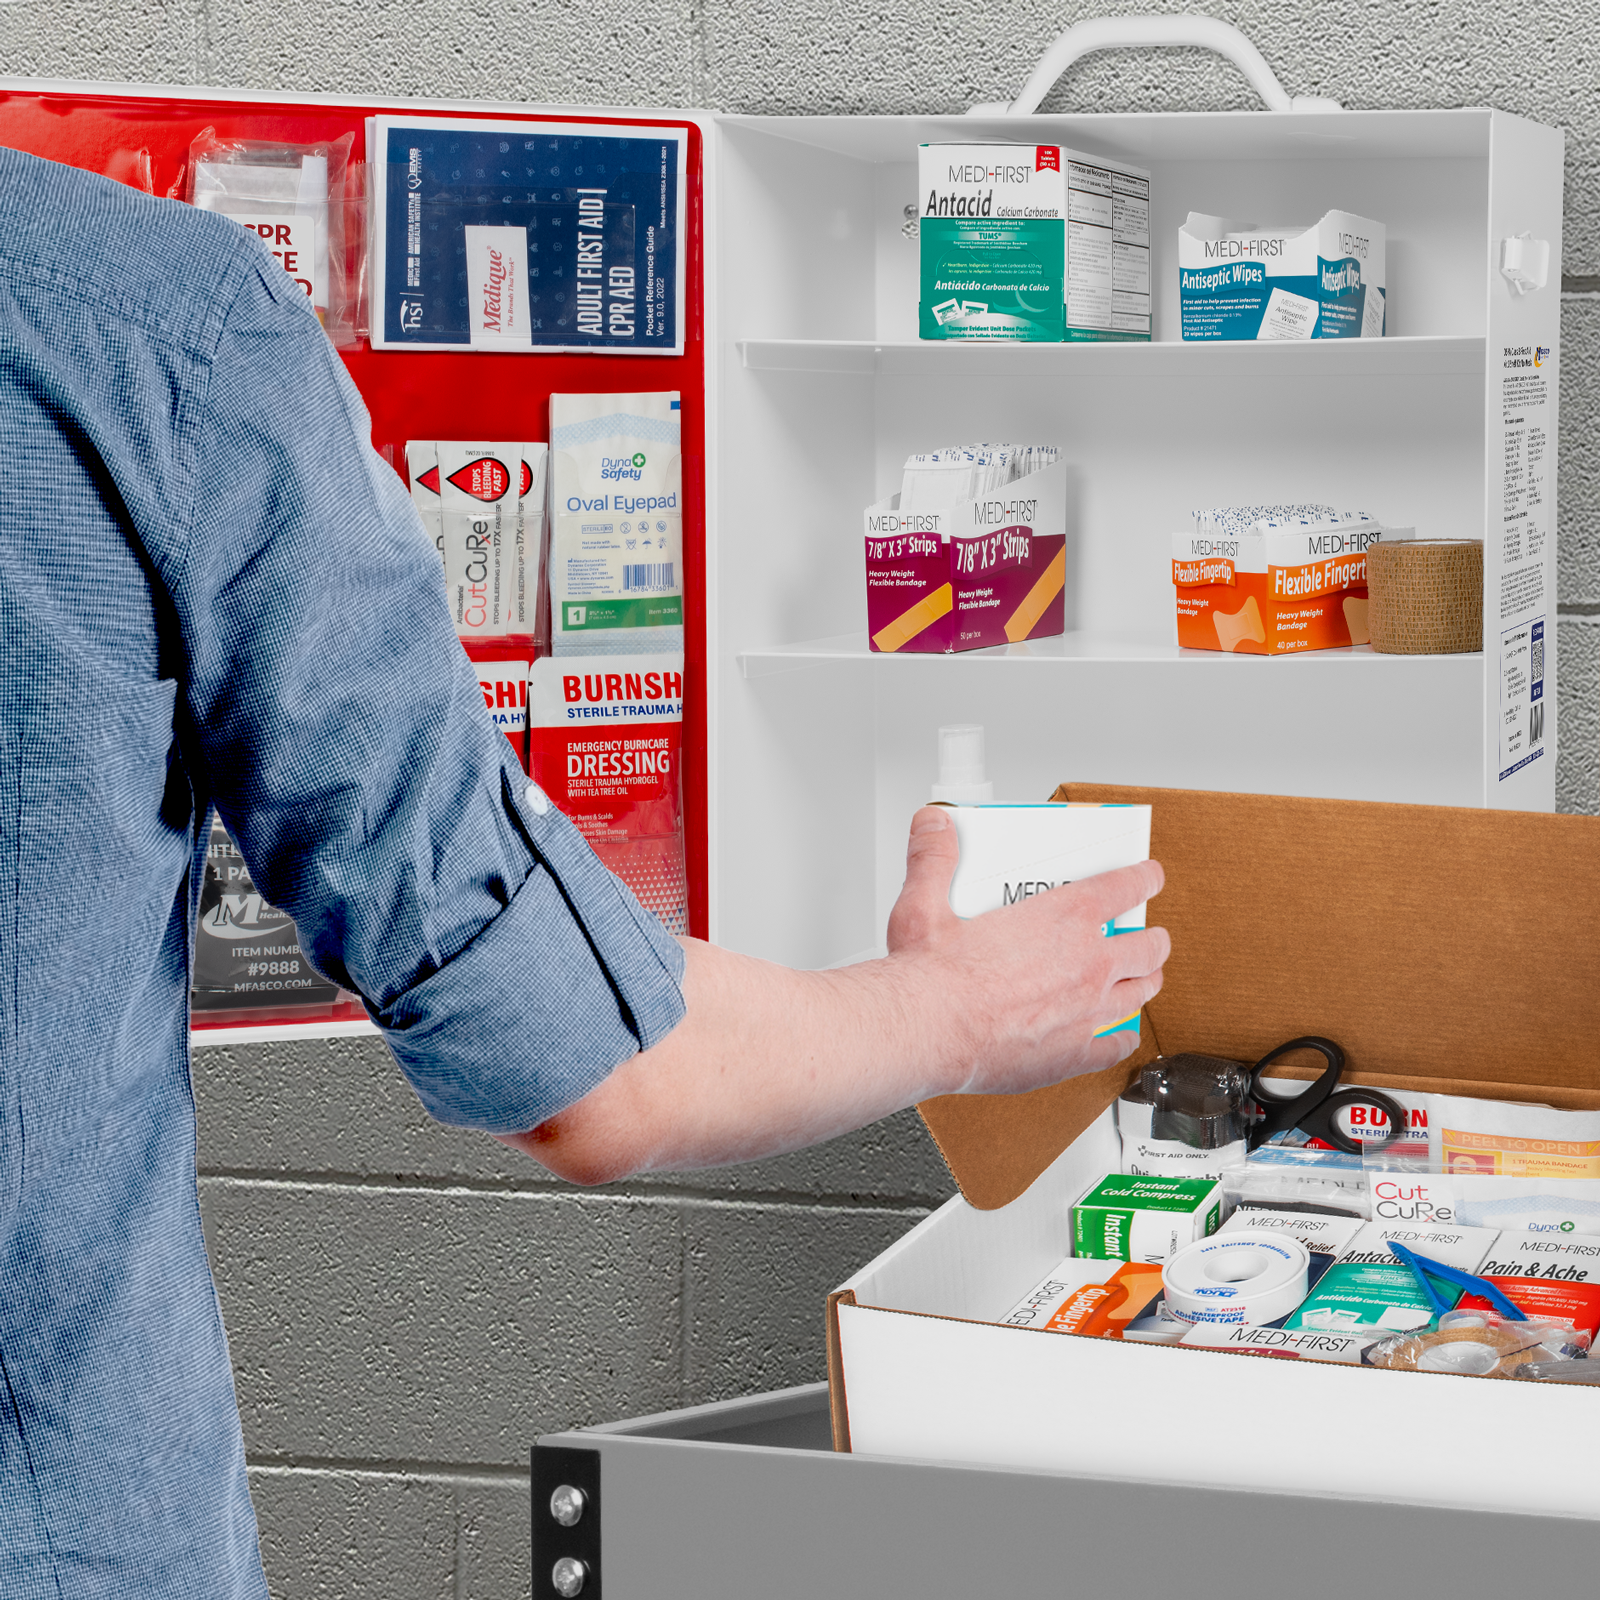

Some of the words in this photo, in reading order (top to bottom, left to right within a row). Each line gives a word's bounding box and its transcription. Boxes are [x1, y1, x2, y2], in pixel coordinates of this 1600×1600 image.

[926, 189, 993, 217] Antacid
[996, 206, 1023, 217] Calcium
[1023, 206, 1059, 218] Carbonate
[579, 199, 604, 229] AID
[243, 224, 292, 246] PR
[646, 225, 655, 253] Guide
[577, 231, 602, 278] FIRST
[609, 266, 635, 300] AED
[645, 255, 654, 302] Reference
[934, 280, 981, 291] Antiácido
[981, 283, 1018, 291] Carbonato
[1182, 267, 1231, 292] Antiseptic
[1232, 264, 1263, 286] Wipes
[656, 277, 665, 299] 2022
[404, 302, 424, 329] hsi
[577, 282, 602, 336] ADULT
[656, 301, 666, 317] 9.0,
[609, 302, 634, 337] CPR
[645, 304, 654, 336] Pocket
[656, 320, 665, 337] Ver.
[601, 457, 632, 470] Dyna
[472, 468, 482, 492] STOPS
[483, 461, 492, 499] BLEEDING
[493, 467, 502, 492] FAST
[600, 467, 642, 481] Safety
[567, 495, 609, 512] Oval
[614, 492, 677, 514] Eyepad
[493, 530, 501, 546] 17X
[516, 528, 524, 545] 17X
[494, 548, 501, 558] TO
[518, 545, 525, 555] TO
[888, 541, 895, 558] X
[909, 535, 937, 557] Strips
[980, 540, 988, 570] X
[1003, 528, 1030, 564] Strips
[494, 558, 501, 568] UP
[518, 556, 525, 566] UP
[869, 570, 890, 579] Heavy
[891, 569, 915, 579] Weight
[1174, 562, 1199, 583] Flexible
[1200, 560, 1231, 584] Fingertip
[1275, 566, 1322, 595] Flexible
[1324, 558, 1367, 589] Fingert
[493, 569, 501, 603] BLEEDING
[518, 567, 526, 601] BLEEDING
[869, 579, 894, 587] Flexible
[894, 579, 927, 588] Bandage
[958, 590, 976, 600] Heavy
[976, 587, 993, 597] Weight
[958, 601, 978, 611] Flexible
[979, 598, 1001, 609] Bandage
[1192, 598, 1209, 607] Weight
[573, 610, 580, 621] 1
[1177, 607, 1198, 616] Bandage
[1276, 611, 1299, 620] Heavy
[1299, 609, 1323, 618] Weight
[1276, 622, 1308, 631] Bandage
[1277, 641, 1285, 649] 40
[1286, 641, 1296, 650] per
[1297, 640, 1308, 648] box
[563, 671, 682, 703] BURNSH
[567, 706, 620, 719] STERILE
[622, 704, 675, 716] TRAUMA
[567, 740, 622, 753] EMERGENCY
[624, 738, 669, 751] BURNCARE
[567, 750, 670, 777] DRESSING
[567, 778, 594, 788] STERILE
[595, 777, 622, 787] TRAUMA
[624, 775, 659, 785] HYDROGEL
[567, 788, 586, 797] WITH
[587, 787, 599, 797] TEA
[600, 786, 616, 796] TREE
[616, 786, 628, 796] OIL
[595, 828, 607, 836] Skin
[607, 828, 628, 836] Damage
[213, 867, 223, 881] 1
[232, 947, 260, 958] ITEM
[264, 945, 302, 957] NUMB
[248, 960, 299, 976] #9888
[234, 979, 312, 992] MFASCO.COM
[1462, 1134, 1500, 1147] PEEL
[1506, 1138, 1528, 1150] TO
[1531, 1140, 1581, 1155] OPEN
[1145, 1150, 1166, 1158] FIRST
[1551, 1161, 1588, 1169] BANDAGE
[1131, 1181, 1180, 1191] Instant
[1375, 1182, 1429, 1200] Cut
[1101, 1188, 1131, 1197] Cold
[1132, 1189, 1197, 1201] Compress
[1104, 1213, 1127, 1257] Instant
[1528, 1222, 1559, 1232] Dyna
[1305, 1241, 1337, 1253] Relief
[1480, 1261, 1523, 1277] Pain
[1524, 1262, 1541, 1276] &
[1540, 1263, 1588, 1282] Ache
[1054, 1288, 1110, 1325] Fingertip
[1363, 1298, 1400, 1307] Carbonato
[1175, 1310, 1218, 1324] ADHESIVE
[1219, 1316, 1245, 1324] TAPE
[1191, 1310, 1245, 1318] WATERPROOF
